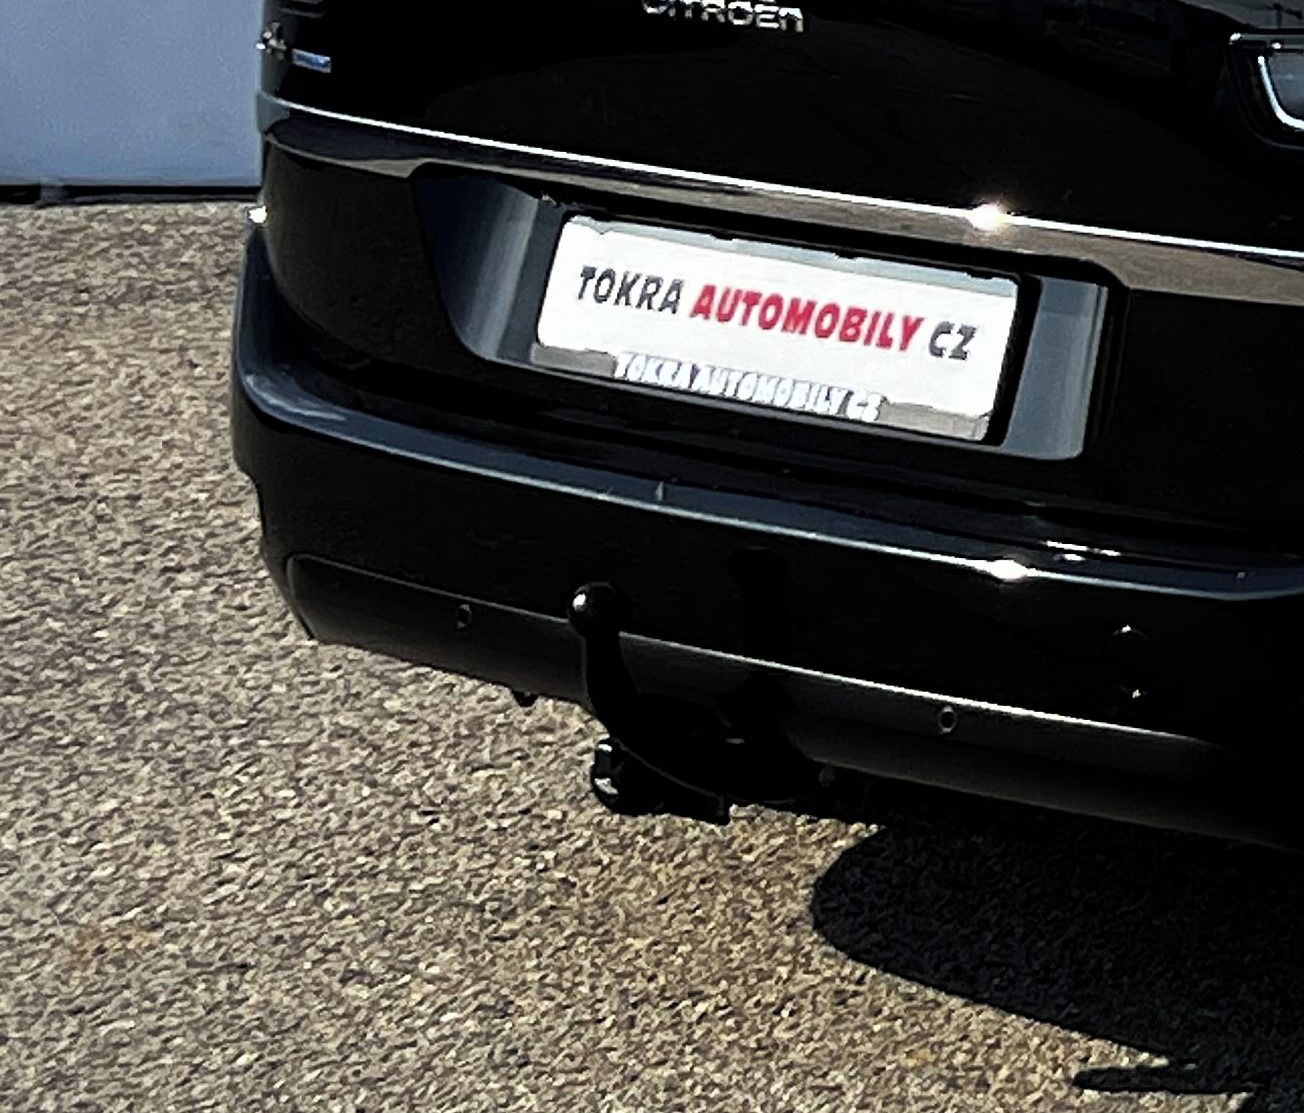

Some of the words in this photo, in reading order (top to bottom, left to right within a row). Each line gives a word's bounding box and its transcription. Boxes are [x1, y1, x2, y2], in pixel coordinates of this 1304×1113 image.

[578, 264, 686, 314] TOKRA
[688, 284, 925, 351] AUTOMOBILY
[929, 320, 979, 361] CZ
